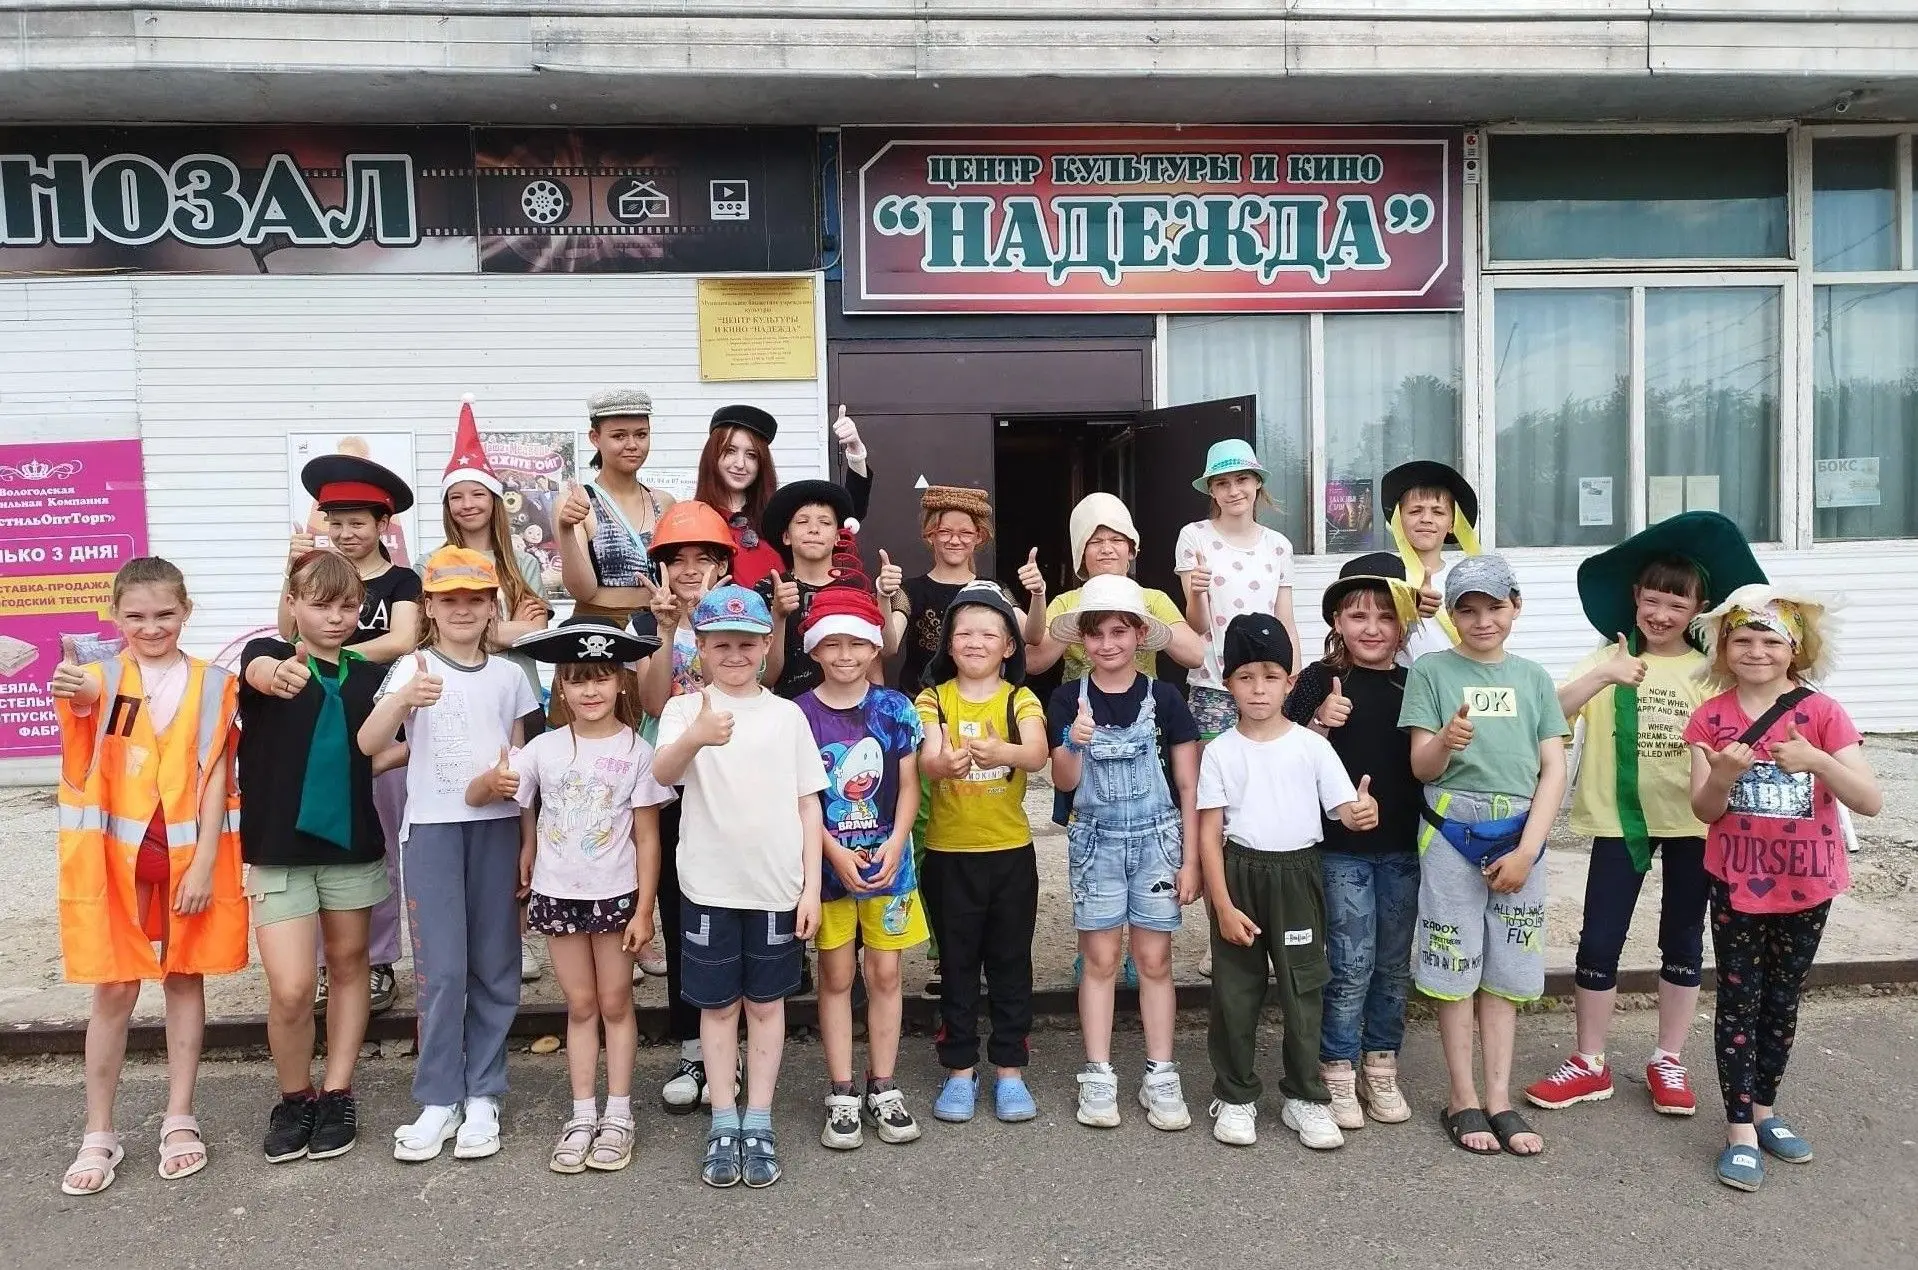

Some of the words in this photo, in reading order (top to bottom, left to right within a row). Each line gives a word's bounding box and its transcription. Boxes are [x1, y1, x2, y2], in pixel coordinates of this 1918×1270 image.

[927, 152, 1043, 189] ЦЕНТР
[1051, 152, 1242, 185] КУЛЬТУРЫ
[1250, 153, 1277, 184] И
[1286, 153, 1384, 185] КИНО
[872, 193, 1435, 286] “НАДЕЖДА”
[753, 316, 799, 324] КУЛЬТУРЫ
[1817, 460, 1858, 473] БОКС
[0, 486, 76, 497] Вологодская
[48, 497, 110, 507] Компания
[0, 548, 46, 563] ЬКО
[51, 546, 64, 561] 3
[69, 545, 119, 563] ДНЯ!
[59, 594, 114, 605] ТЕКСТИЛ
[1649, 688, 1667, 696] NOW
[0, 696, 54, 708] СТЕЛЬН
[1472, 689, 1511, 712] OK
[1649, 697, 1666, 705] TIME
[1667, 700, 1689, 709] WHEN
[0, 710, 58, 723] ТПУСКН
[1657, 707, 1673, 715] AND
[1674, 709, 1690, 718] SMIL
[18, 725, 60, 736] ФАБР
[1648, 723, 1674, 732] WHERE
[1637, 732, 1668, 740] DREAMS
[1664, 750, 1682, 758] WITH
[967, 771, 1001, 780] MOKIN'
[837, 819, 879, 831] BRAWL
[1494, 903, 1511, 915] ALL
[1507, 928, 1533, 946] FLY
